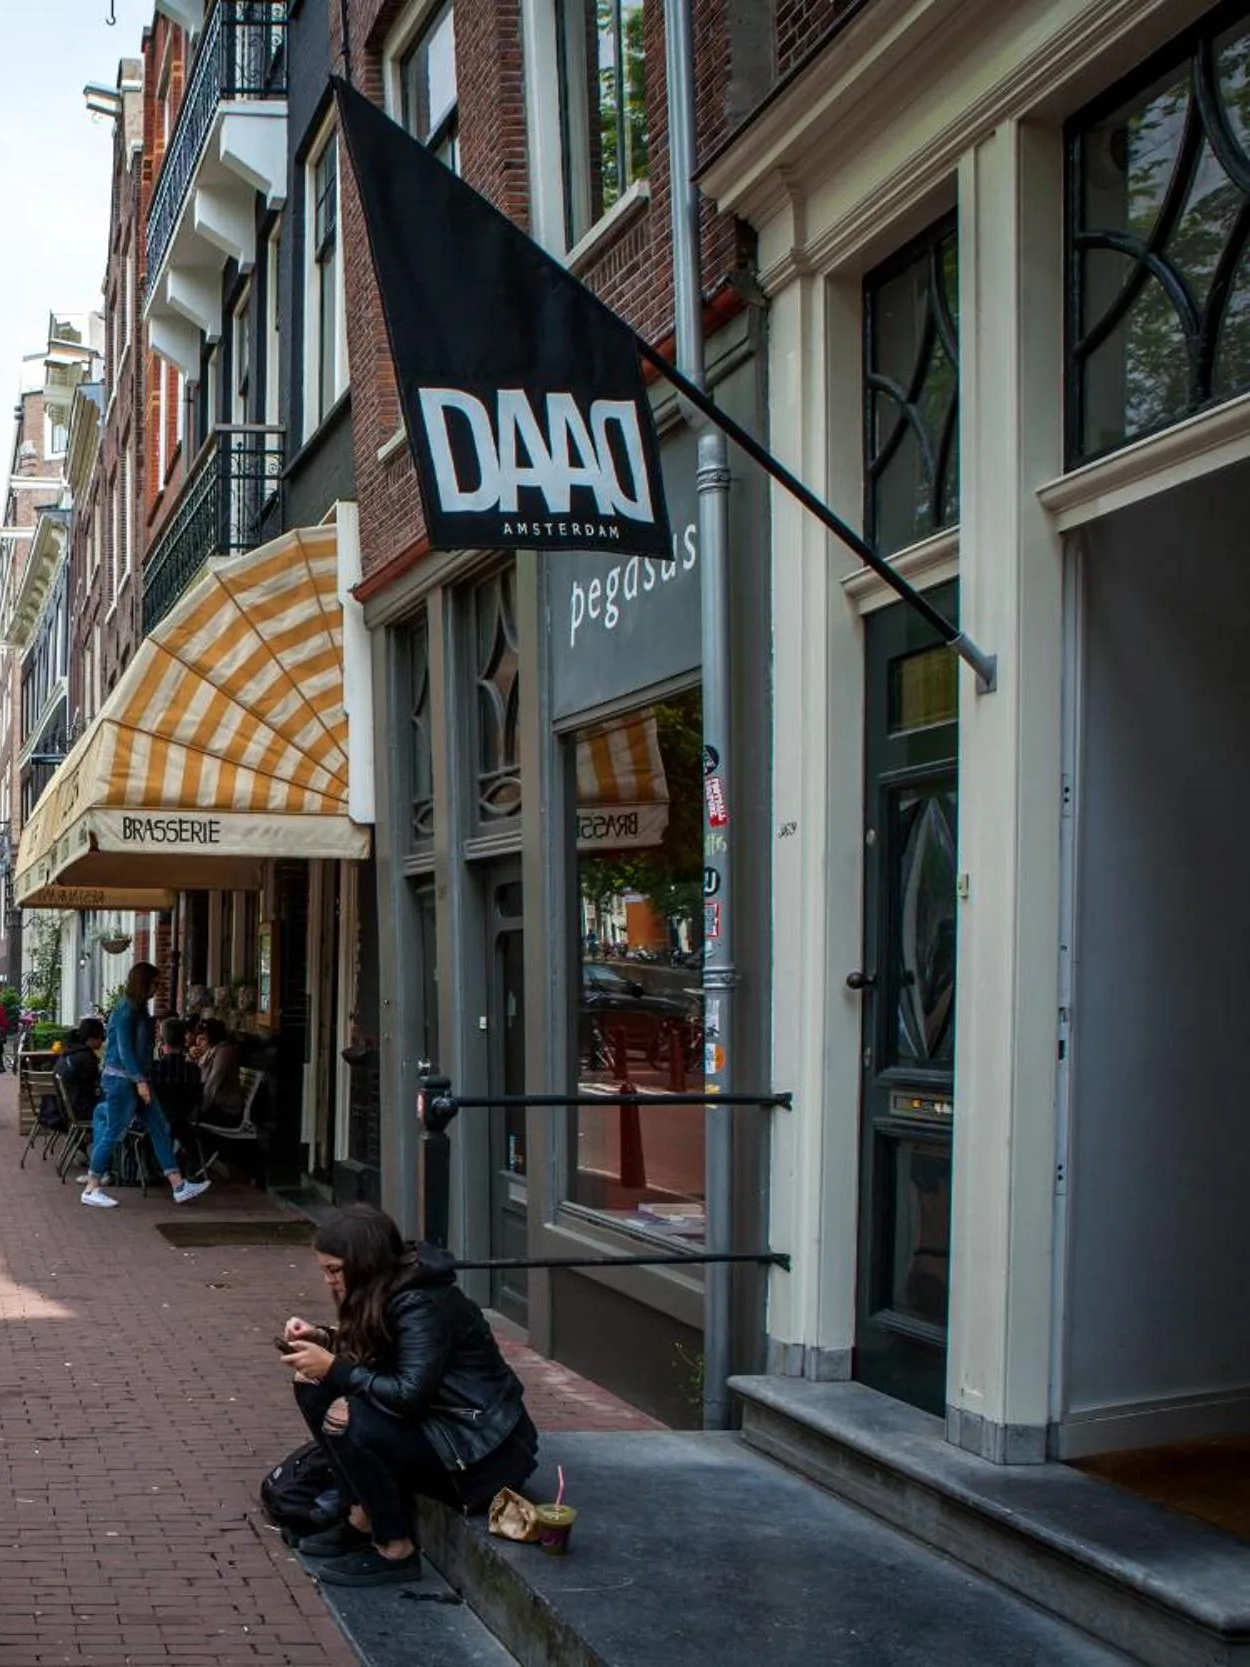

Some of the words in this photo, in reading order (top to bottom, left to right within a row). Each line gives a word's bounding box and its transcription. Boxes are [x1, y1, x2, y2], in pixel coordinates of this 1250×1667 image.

[503, 521, 620, 540] AMSTERDAM
[570, 523, 697, 648] pegasus
[122, 816, 221, 844] BRASSERIE
